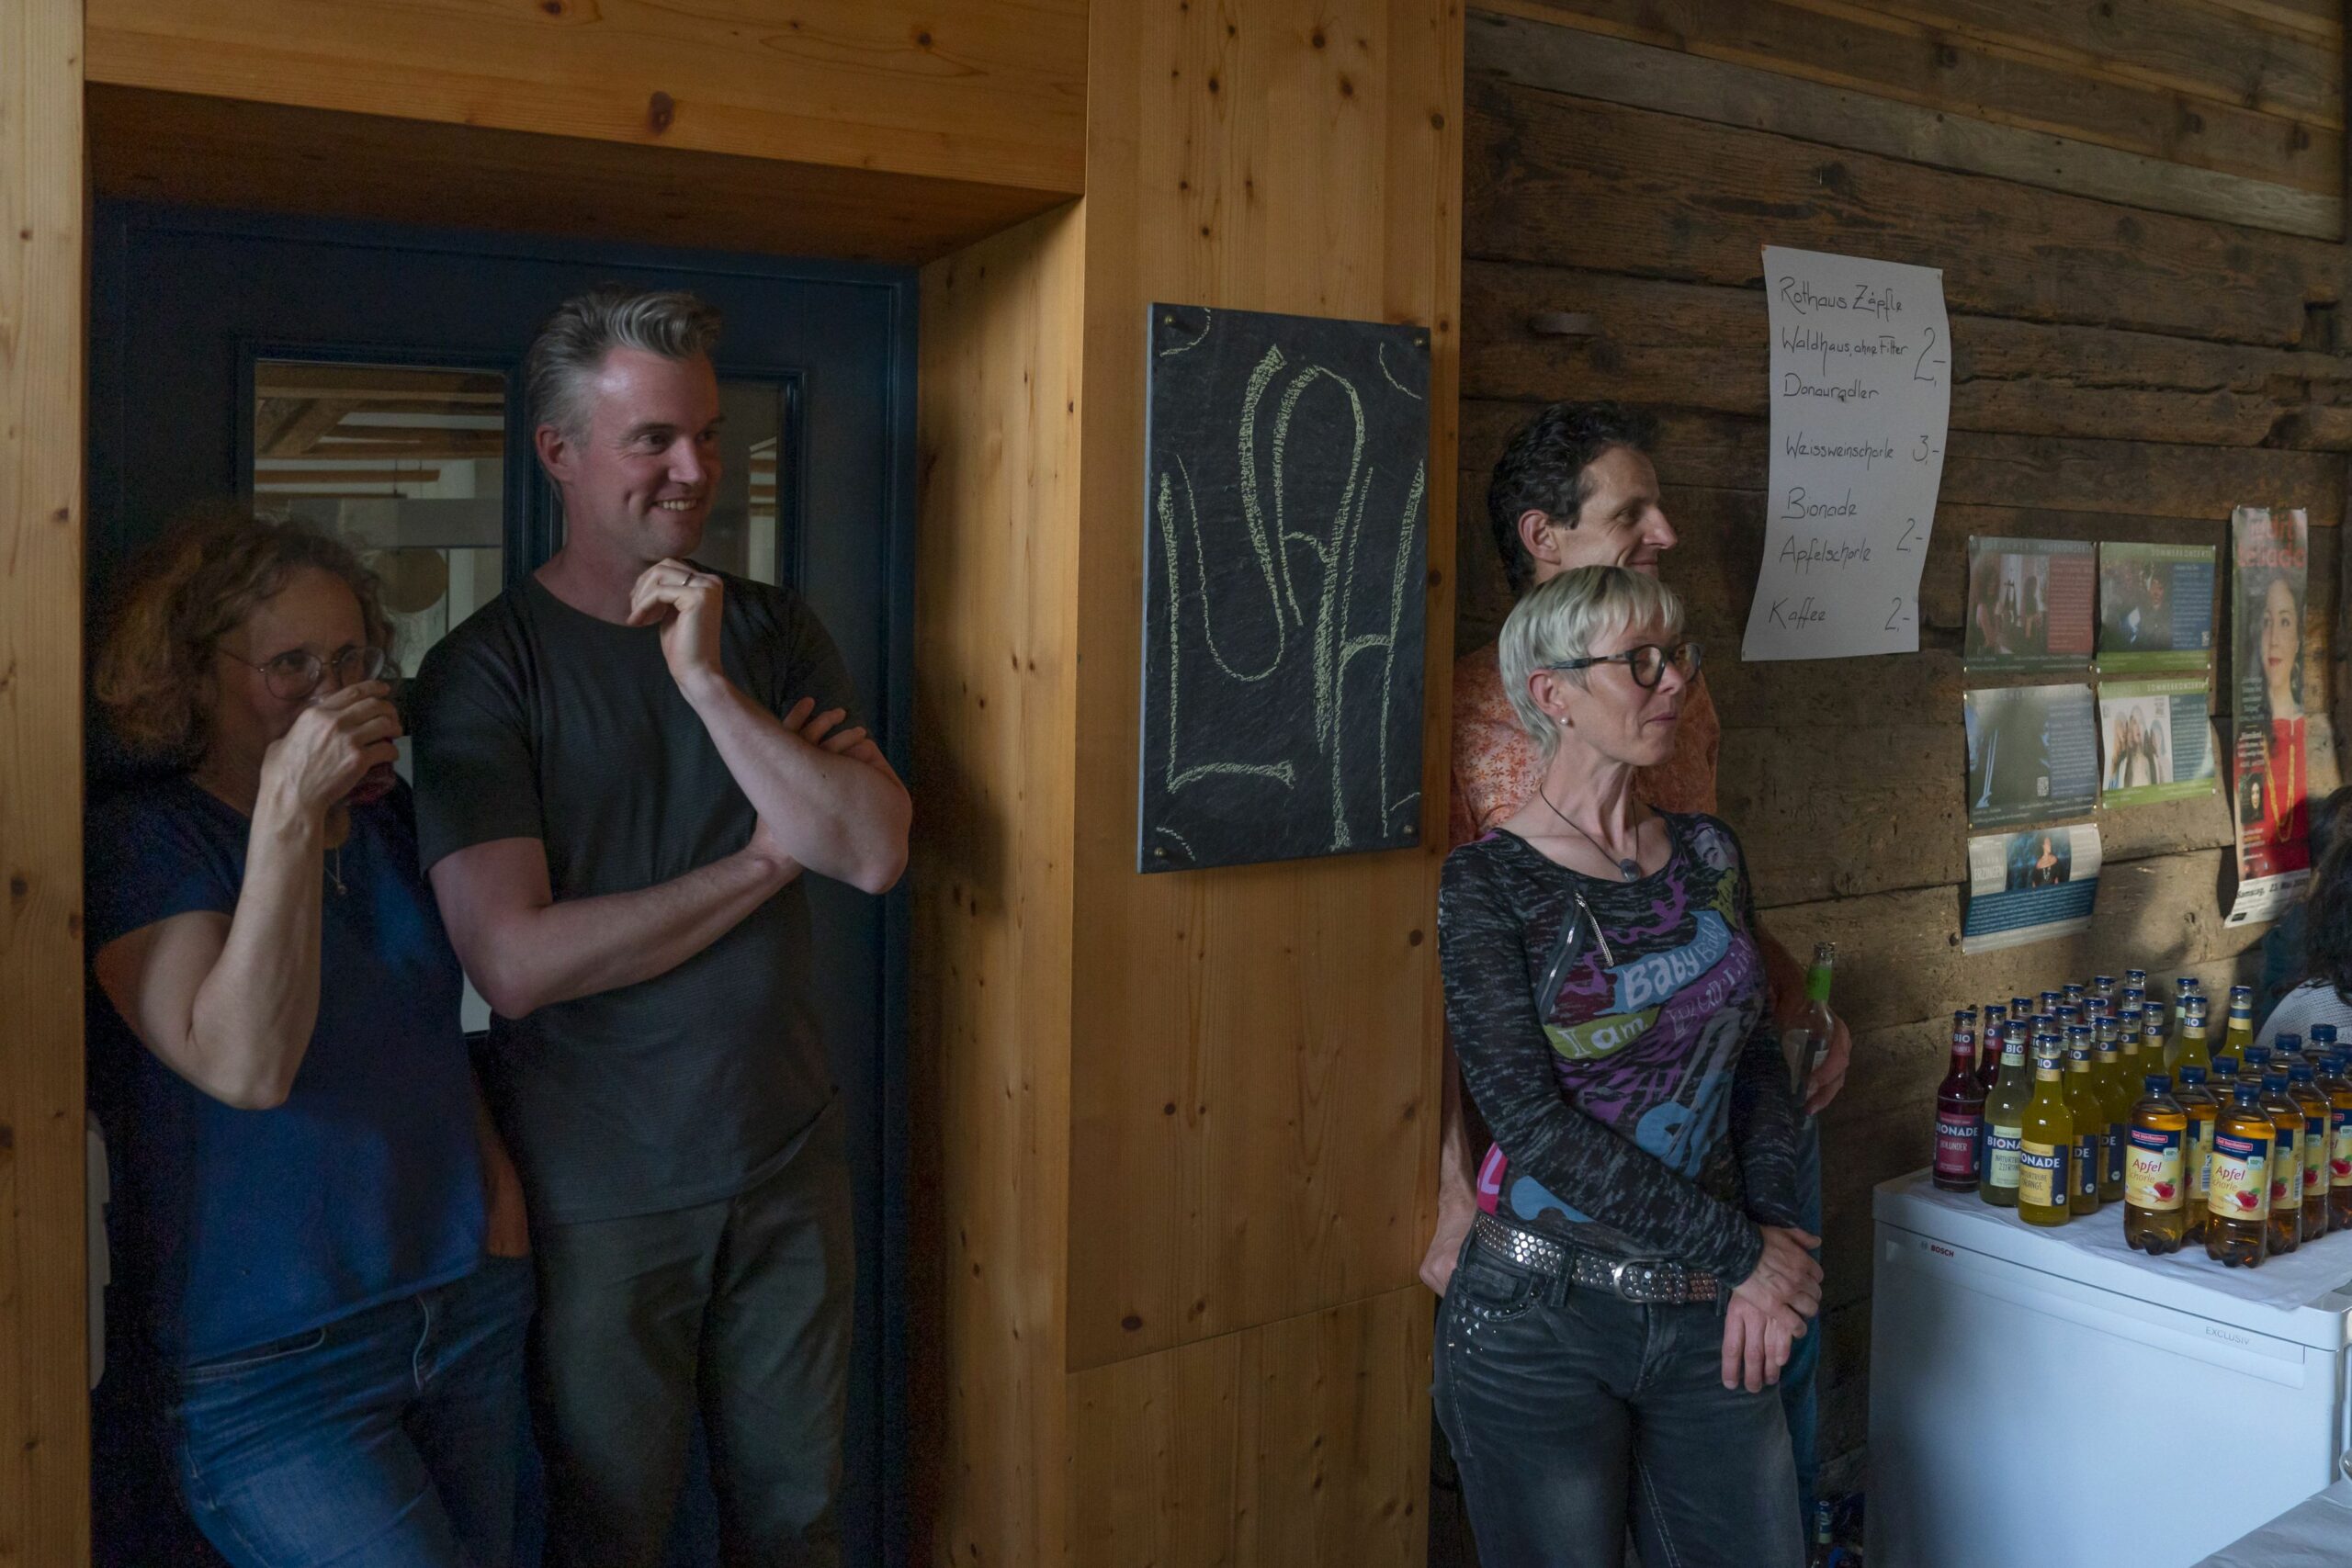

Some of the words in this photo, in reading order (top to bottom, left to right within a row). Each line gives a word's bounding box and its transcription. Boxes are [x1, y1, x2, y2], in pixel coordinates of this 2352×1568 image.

[1780, 276, 1847, 314] Rothaus
[1879, 335, 1909, 355] Filter
[1783, 372, 1880, 402] Donauradler
[1786, 431, 1894, 471] Weissweinschorle
[1781, 487, 1858, 519] Bionade
[1779, 535, 1871, 574] Apfelschorle
[1769, 597, 1826, 630] Kaffee
[1623, 949, 1700, 1009] Baby
[1556, 1028, 1592, 1057] I
[2006, 1043, 2024, 1054] BIO
[1987, 1135, 2021, 1149] BIONA
[2021, 1153, 2061, 1168] ONADE
[2132, 1158, 2162, 1174] Apfel
[2215, 1165, 2245, 1181] Apfel
[1930, 1244, 1954, 1258] BOSCH
[2205, 1325, 2250, 1346] EXCLUSIV
